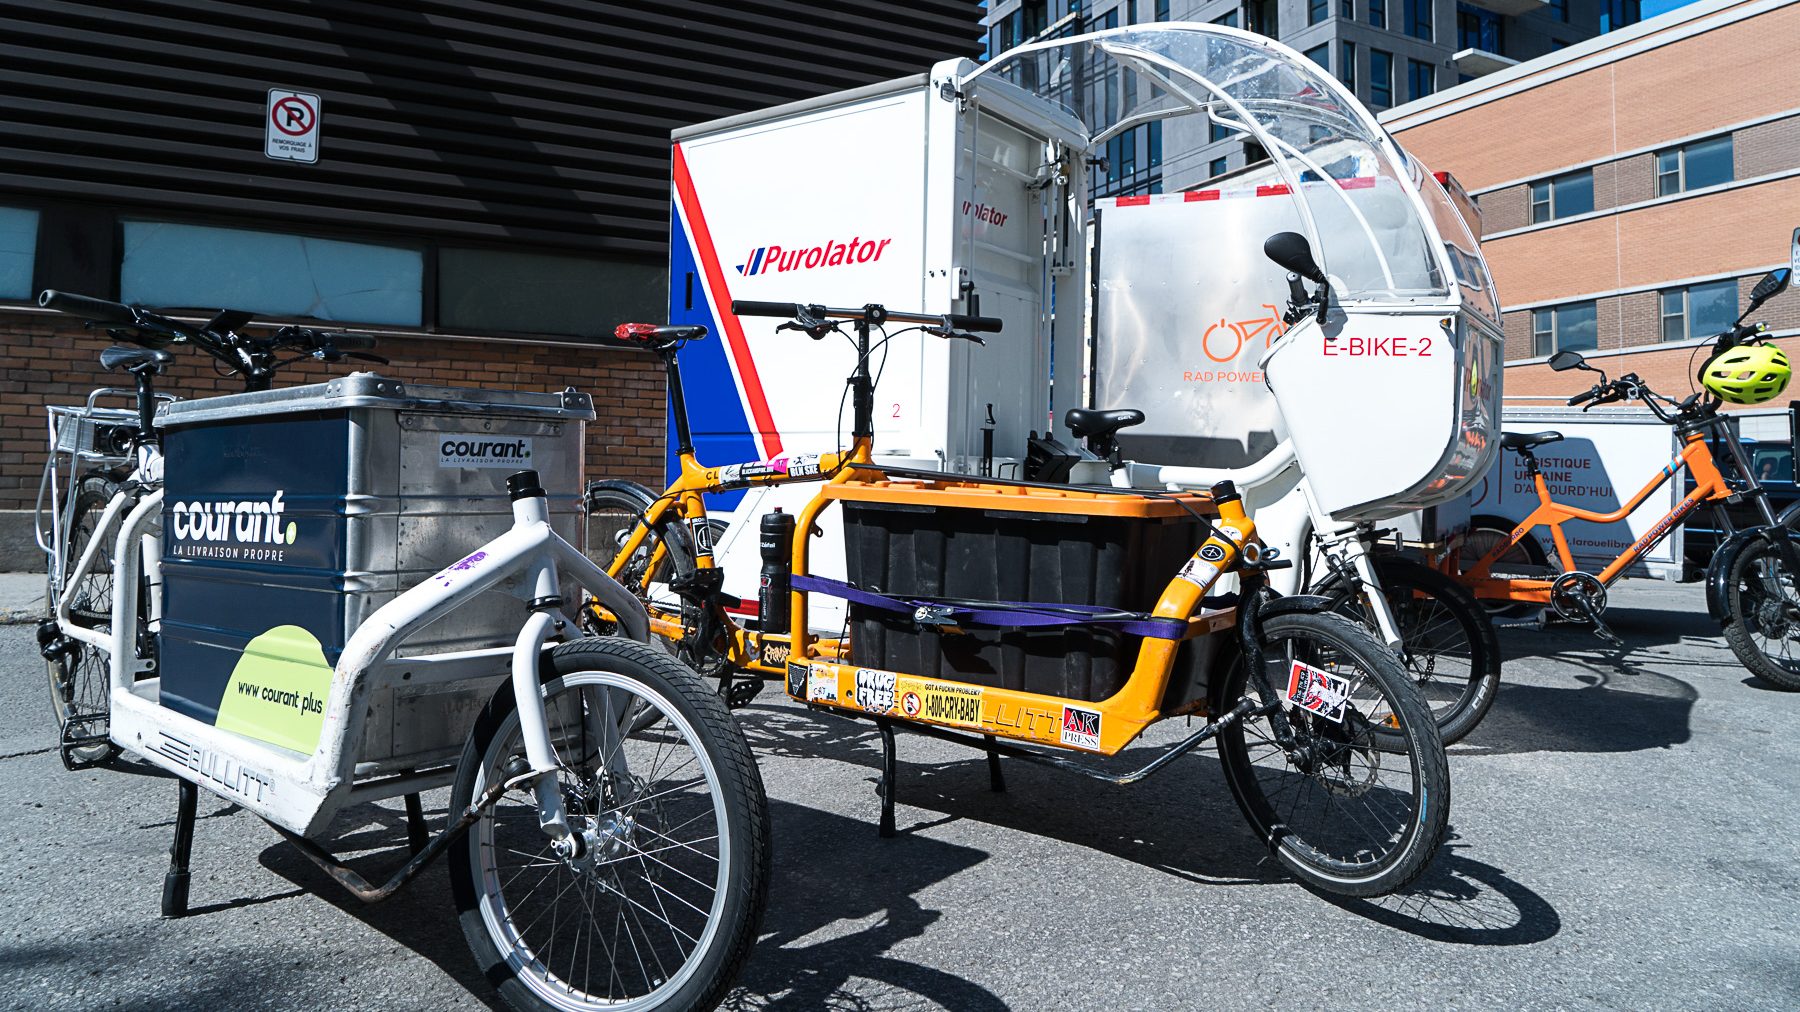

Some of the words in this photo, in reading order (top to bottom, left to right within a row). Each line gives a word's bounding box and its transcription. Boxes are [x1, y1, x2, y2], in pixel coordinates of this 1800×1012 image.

[272, 138, 306, 147] REMORQUAGE
[761, 237, 892, 274] Purolator
[1323, 337, 1432, 357] E-BIKE-2
[1183, 371, 1214, 382] RAD
[1217, 371, 1265, 382] POWE
[892, 403, 901, 418] 2
[1514, 470, 1573, 482] URAINE
[1514, 482, 1613, 498] D'AOURD'HUI
[1633, 537, 1649, 553] RAD
[1647, 516, 1673, 539] POWER
[1672, 497, 1695, 518] BIKES
[173, 545, 183, 555] LA
[187, 545, 239, 559] LIVRAISON
[243, 549, 284, 562] PROPRE
[856, 669, 895, 690] DRUG
[856, 687, 894, 709] FREE
[939, 685, 955, 693] FUCKIN
[925, 693, 981, 723] 1-800-CRY-BABY
[1063, 710, 1098, 736] AK
[1064, 732, 1097, 746] PRESS
[188, 744, 270, 802] BULLITT
